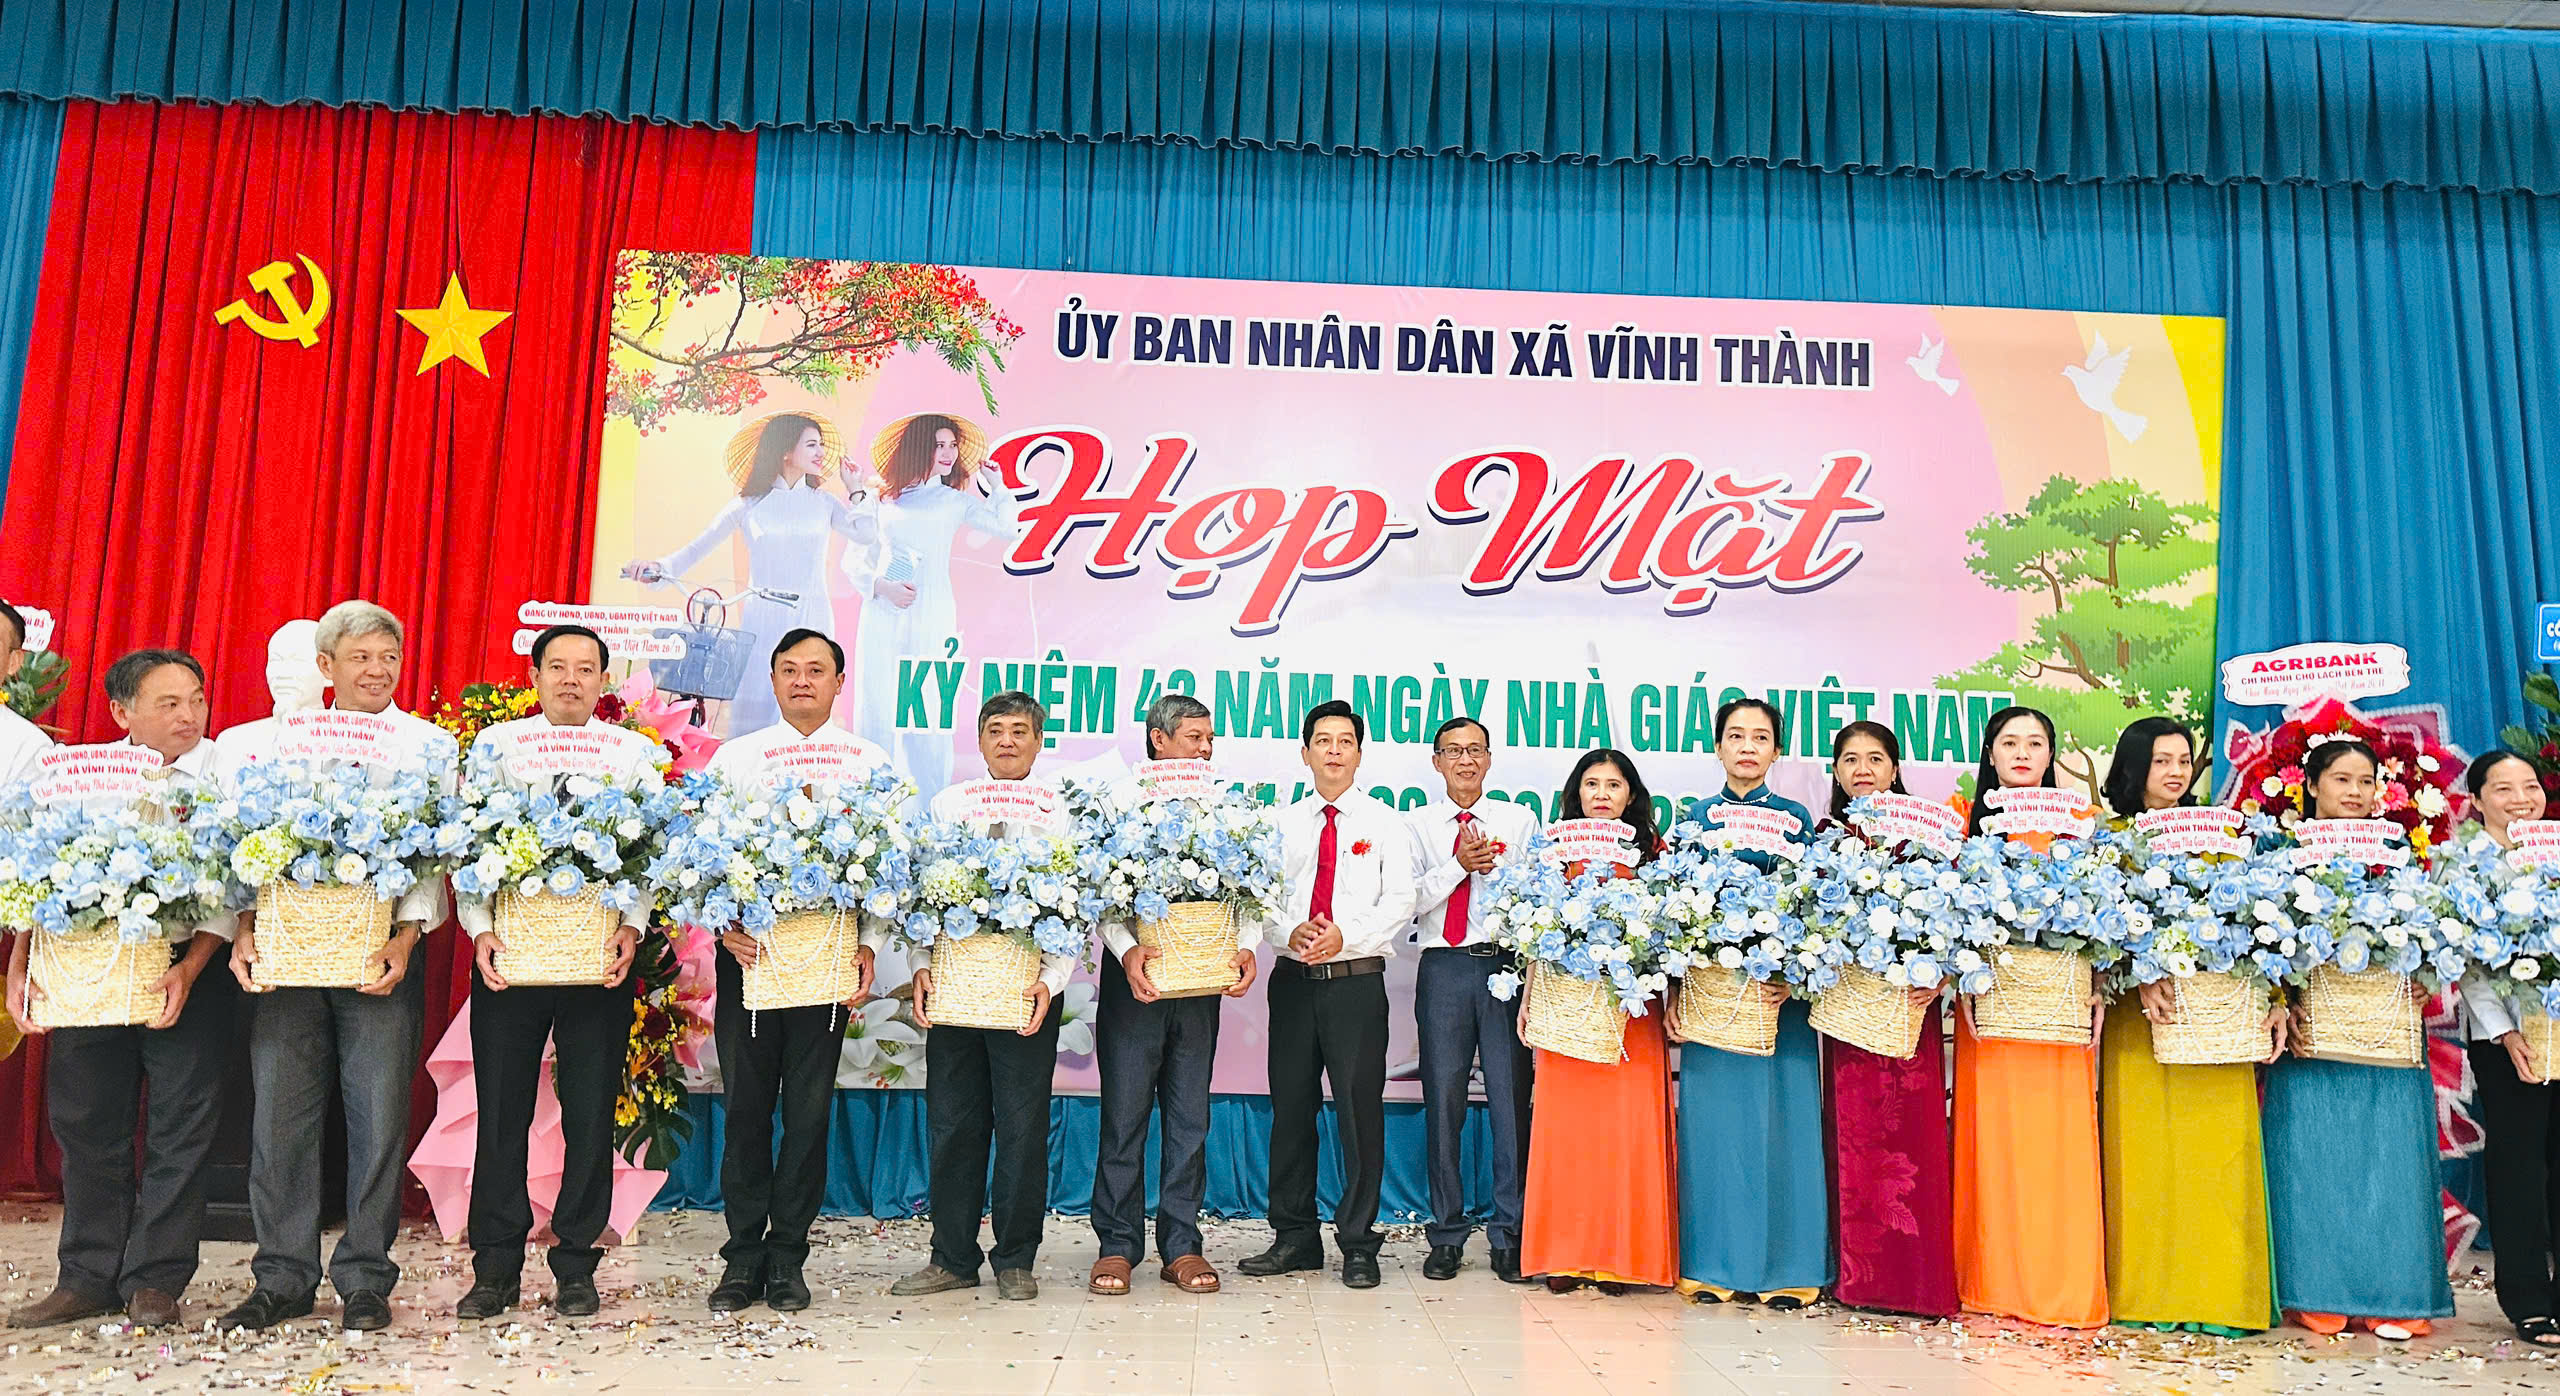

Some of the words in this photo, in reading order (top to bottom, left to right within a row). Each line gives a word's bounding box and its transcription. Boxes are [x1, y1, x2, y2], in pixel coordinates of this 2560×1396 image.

[1057, 297, 1119, 360] ỦY
[1133, 315, 1232, 365] BAN
[1248, 314, 1381, 370] NHÂN
[1397, 319, 1494, 375] DÂN
[1509, 323, 1573, 378] XÃ
[1588, 325, 1698, 382] VĨNH
[1714, 330, 1870, 387] THÀNH
[984, 428, 1418, 637] Họp
[1428, 450, 1882, 617] Mặt
[895, 637, 966, 729] KỶ
[1213, 656, 1334, 740] NĂM
[1352, 662, 1490, 744] NGÀY
[1506, 667, 1613, 751] NHÀ
[1630, 671, 1746, 753] GIÁ
[2251, 651, 2379, 674] AGRIBANK
